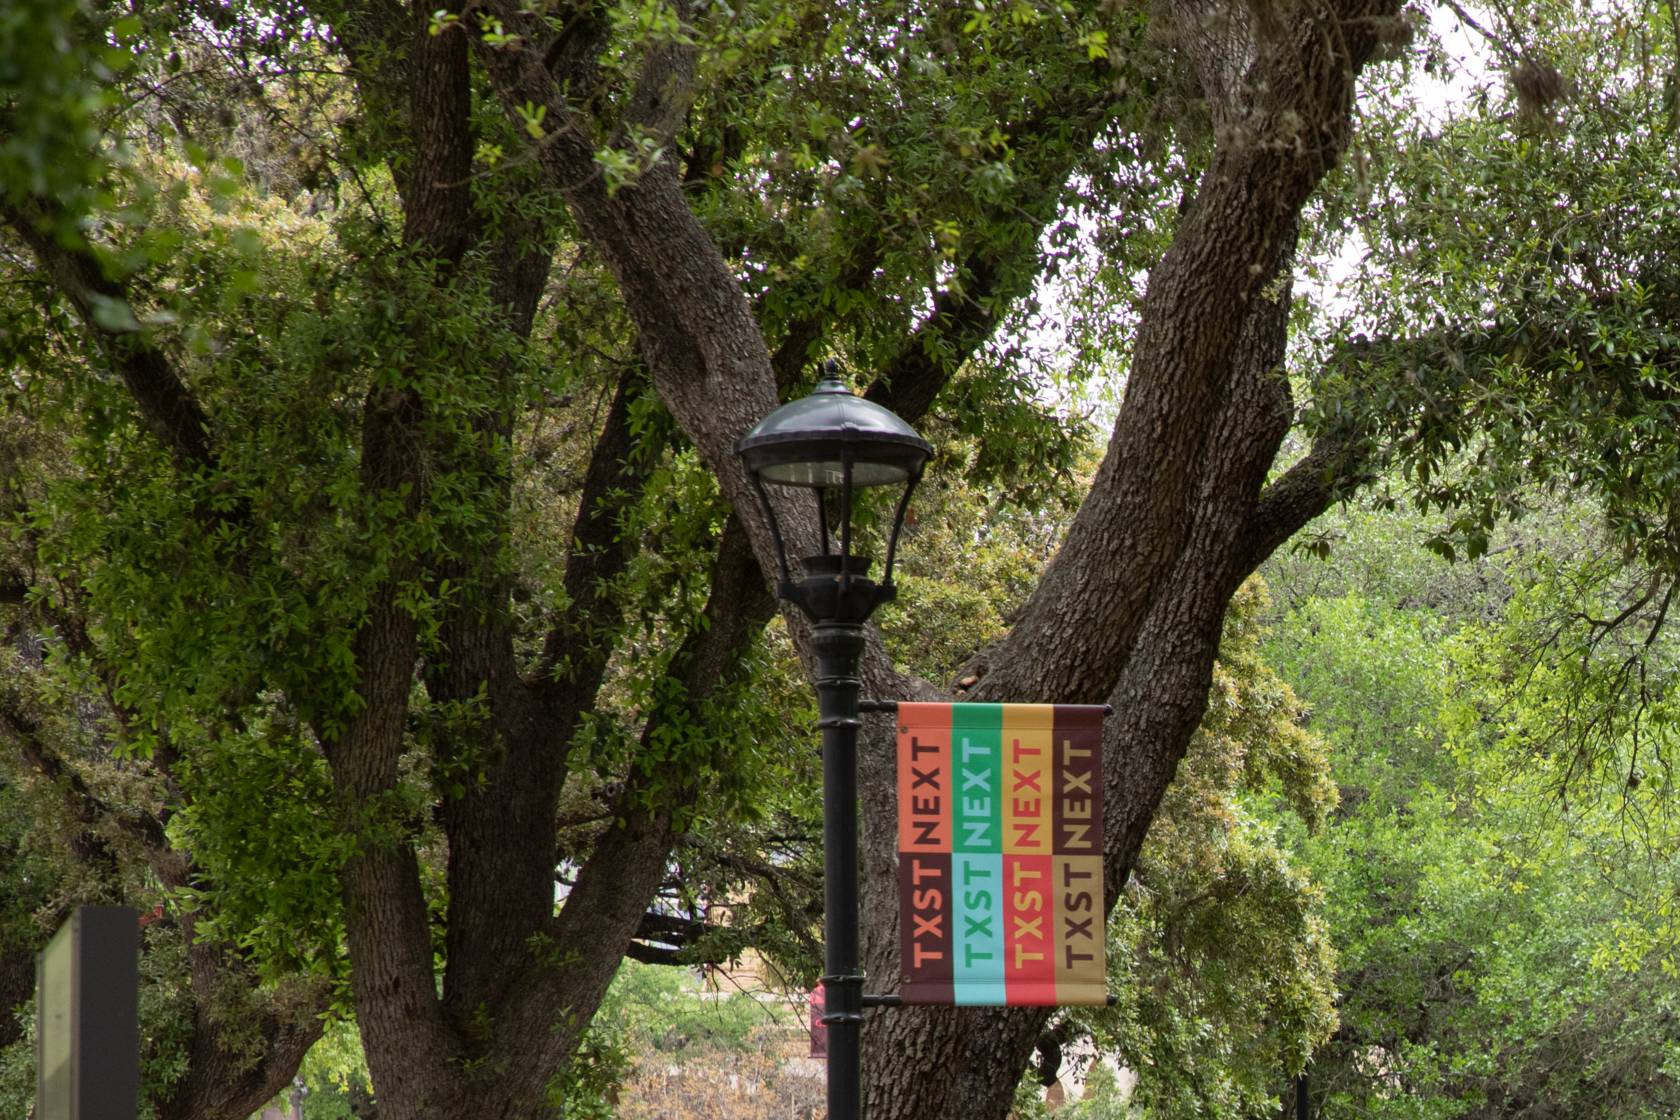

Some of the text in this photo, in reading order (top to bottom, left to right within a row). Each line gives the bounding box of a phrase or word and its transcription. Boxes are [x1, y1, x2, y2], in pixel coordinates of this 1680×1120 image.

[911, 736, 943, 968] TXST NEXT
[962, 737, 993, 968] TXST NEXT
[1012, 738, 1045, 969] TXST NEXT
[1063, 739, 1094, 970] TXST NEXT
